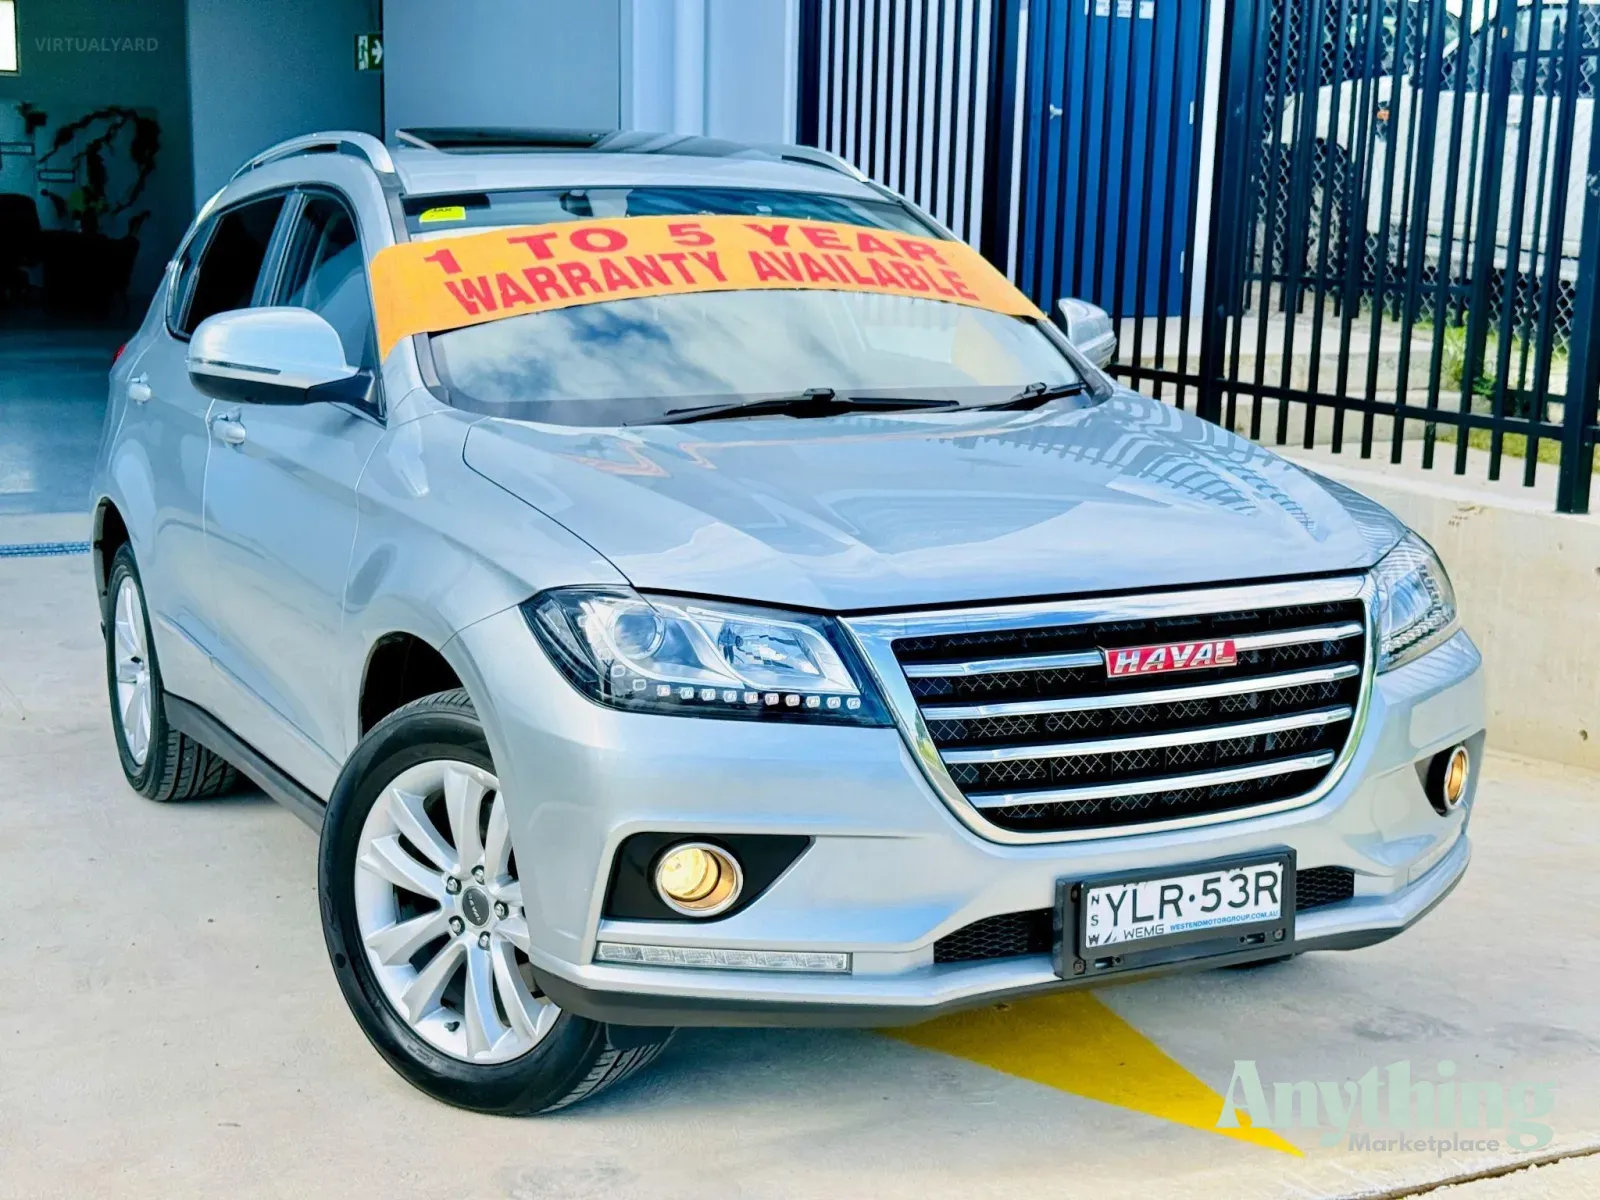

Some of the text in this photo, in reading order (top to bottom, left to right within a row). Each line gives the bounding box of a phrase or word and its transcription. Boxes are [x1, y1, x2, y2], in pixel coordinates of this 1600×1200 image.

[424, 223, 950, 275] 1 TO 5 YEAR
[444, 250, 981, 316] WARRANTY AVAILABLE
[1113, 642, 1235, 674] HAVAL
[1123, 923, 1165, 940] WEMG
[1169, 910, 1279, 932] WESTENDMOTORGROUP.COM.AU
